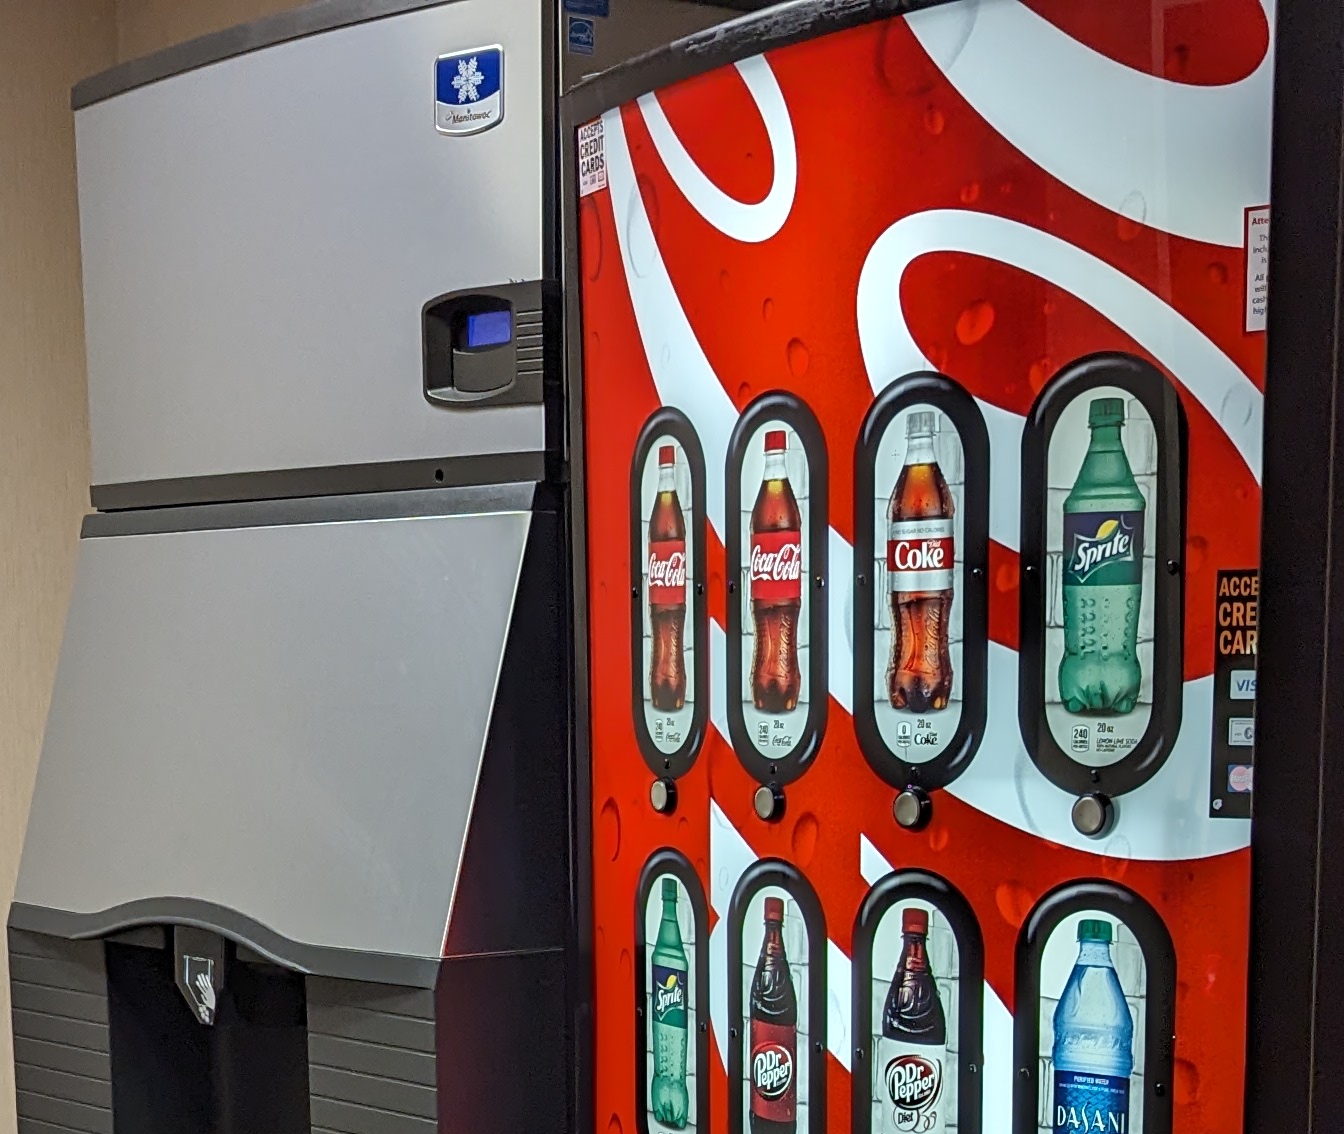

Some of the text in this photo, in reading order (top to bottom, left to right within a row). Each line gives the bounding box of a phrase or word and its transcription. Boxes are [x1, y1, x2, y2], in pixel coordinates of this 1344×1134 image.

[580, 120, 604, 141] ACCEPTS
[580, 135, 604, 159] CREDIT
[581, 153, 604, 177] CARDS
[751, 544, 801, 580] Coca-Cola
[894, 541, 944, 569] Coke
[1074, 529, 1130, 572] Sprite
[649, 552, 685, 586] Coca-Cola
[1219, 576, 1259, 596] ACCE
[1219, 602, 1257, 627] CRE
[1219, 630, 1257, 655] CAR
[1236, 679, 1255, 692] VIS
[914, 733, 938, 745] Coke
[1074, 728, 1087, 738] 240
[1097, 722, 1106, 733] 20
[657, 984, 682, 1012] Sprite
[756, 1053, 790, 1090] Pepper
[766, 1051, 782, 1071] Dr
[892, 1065, 935, 1103] Pepper
[905, 1063, 924, 1084] Dr
[898, 1112, 913, 1124] Diet
[1057, 1101, 1125, 1134] DASANI
